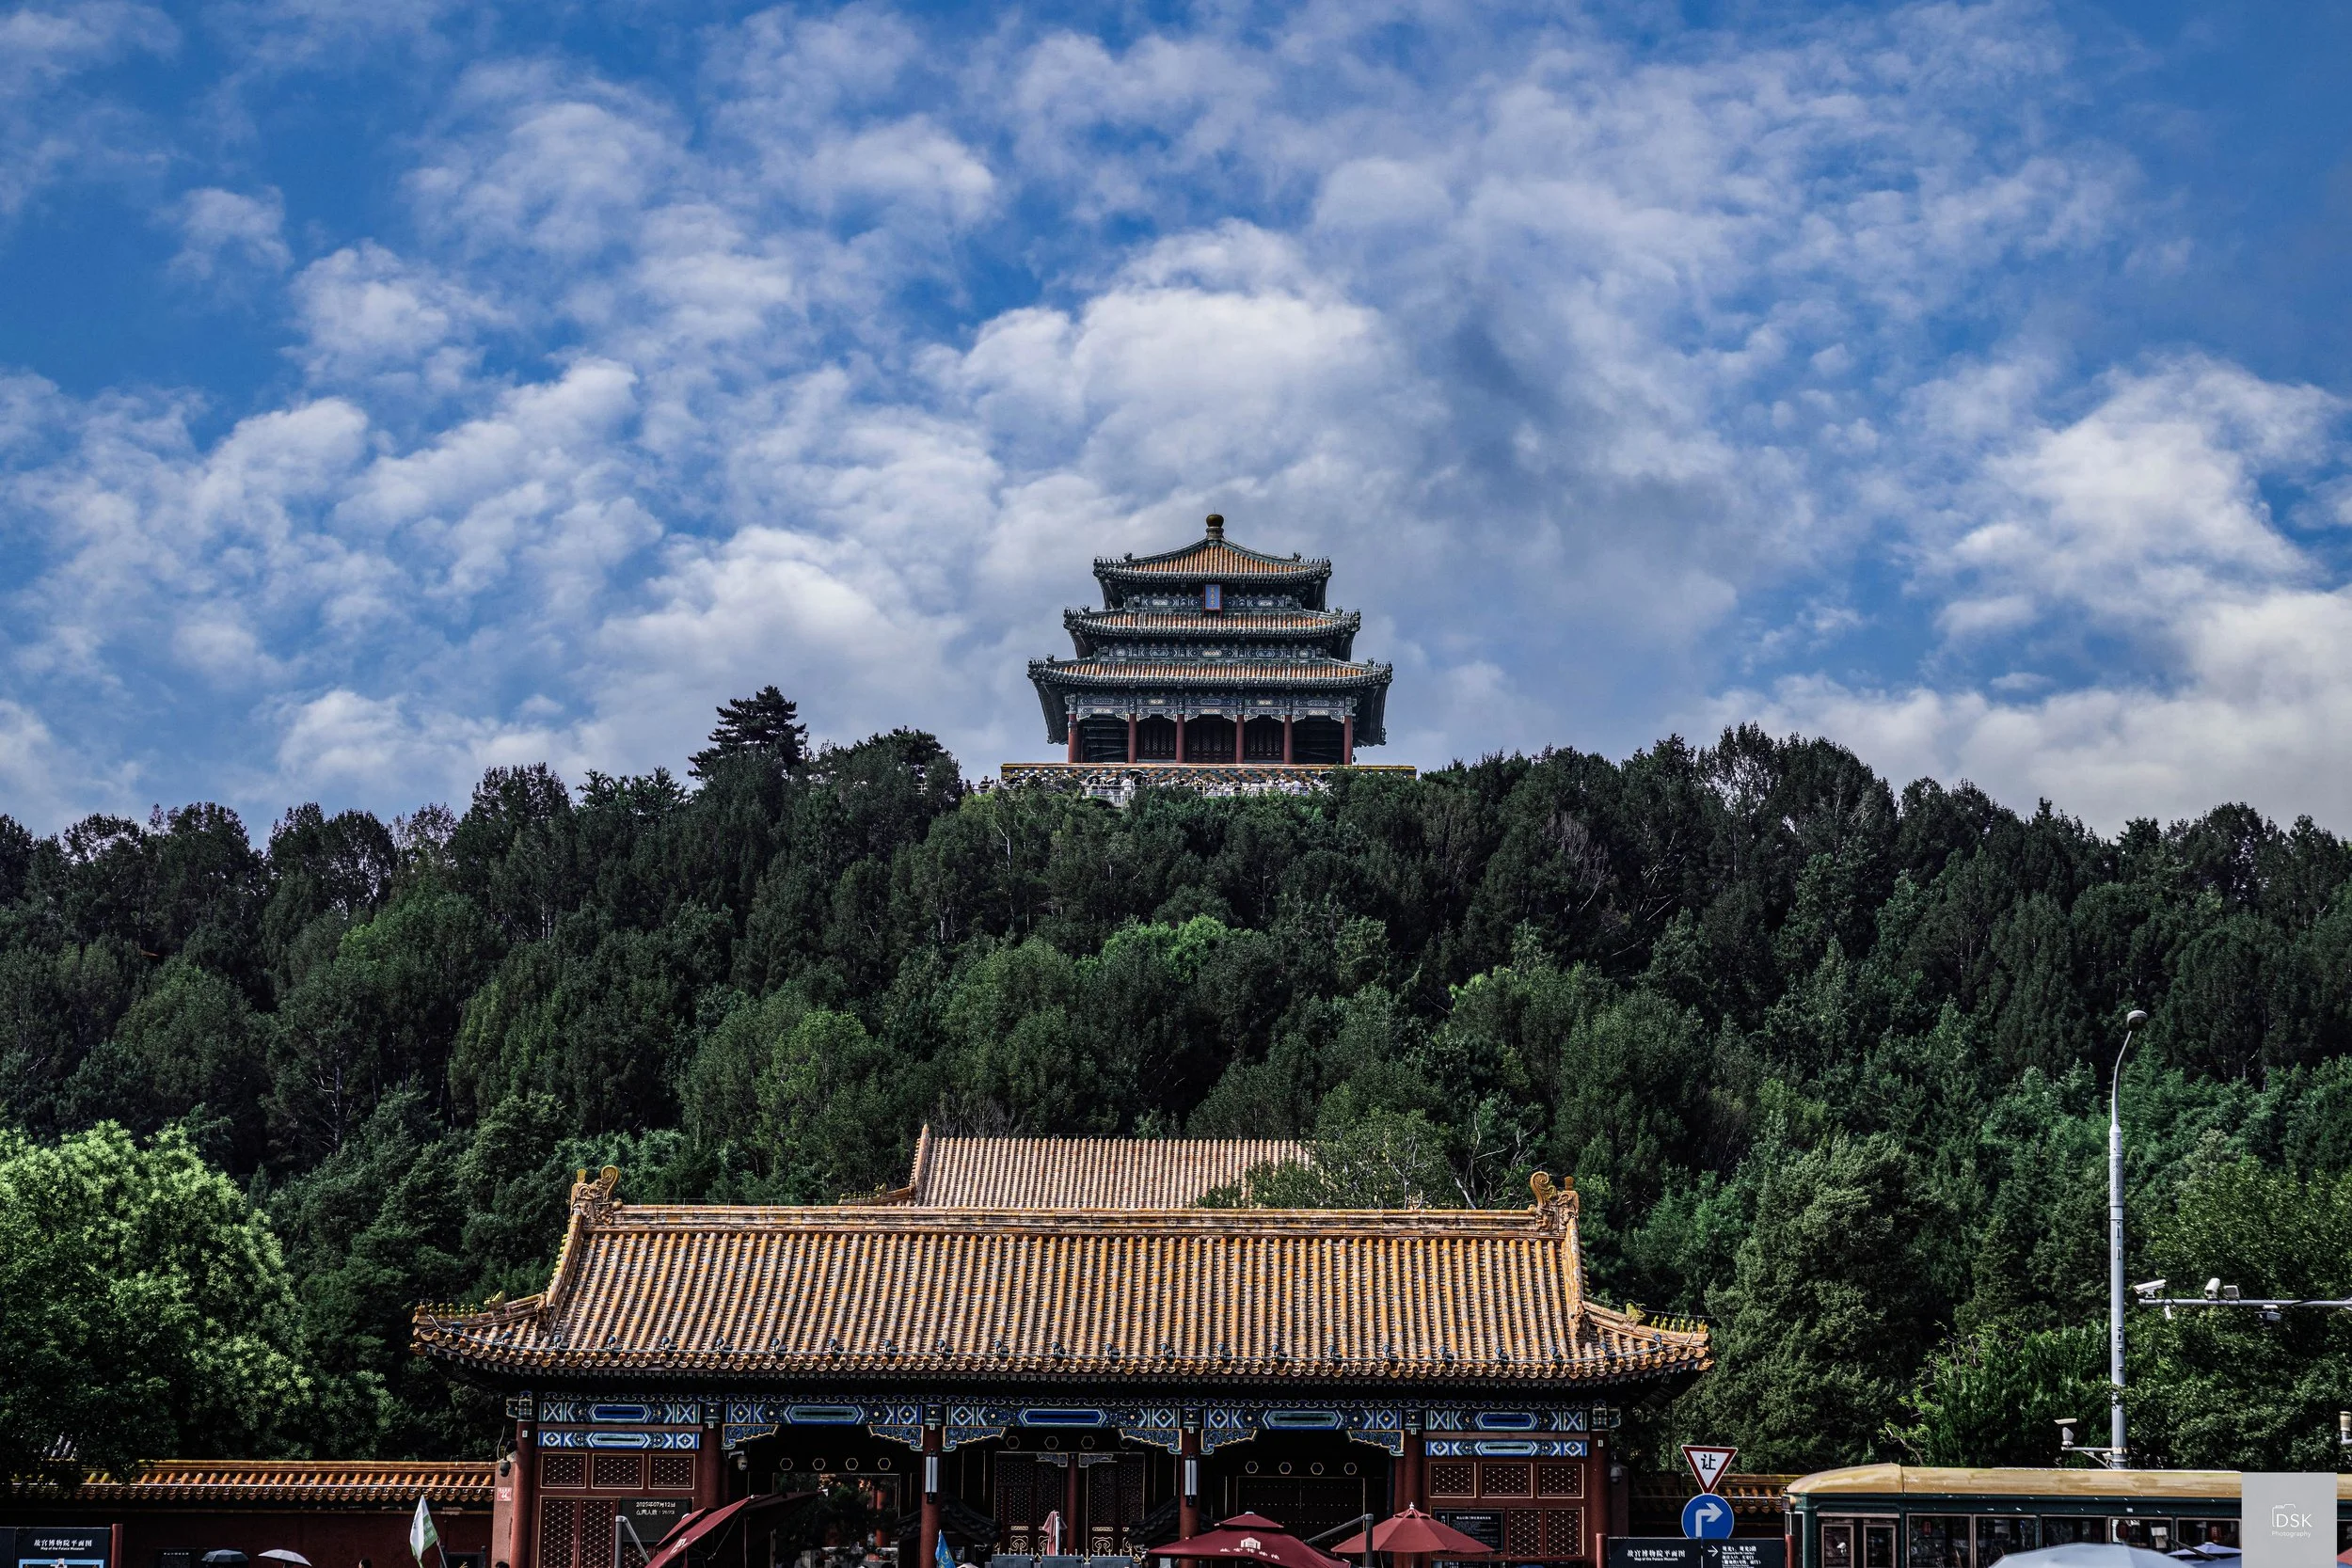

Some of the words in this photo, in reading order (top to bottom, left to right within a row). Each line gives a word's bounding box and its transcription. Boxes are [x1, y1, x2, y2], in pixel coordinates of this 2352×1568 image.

[1701, 1453, 1716, 1470] 让
[34, 1539, 92, 1547] 故宫博物院平面图
[1627, 1549, 1686, 1558] 故宫博物院平面图
